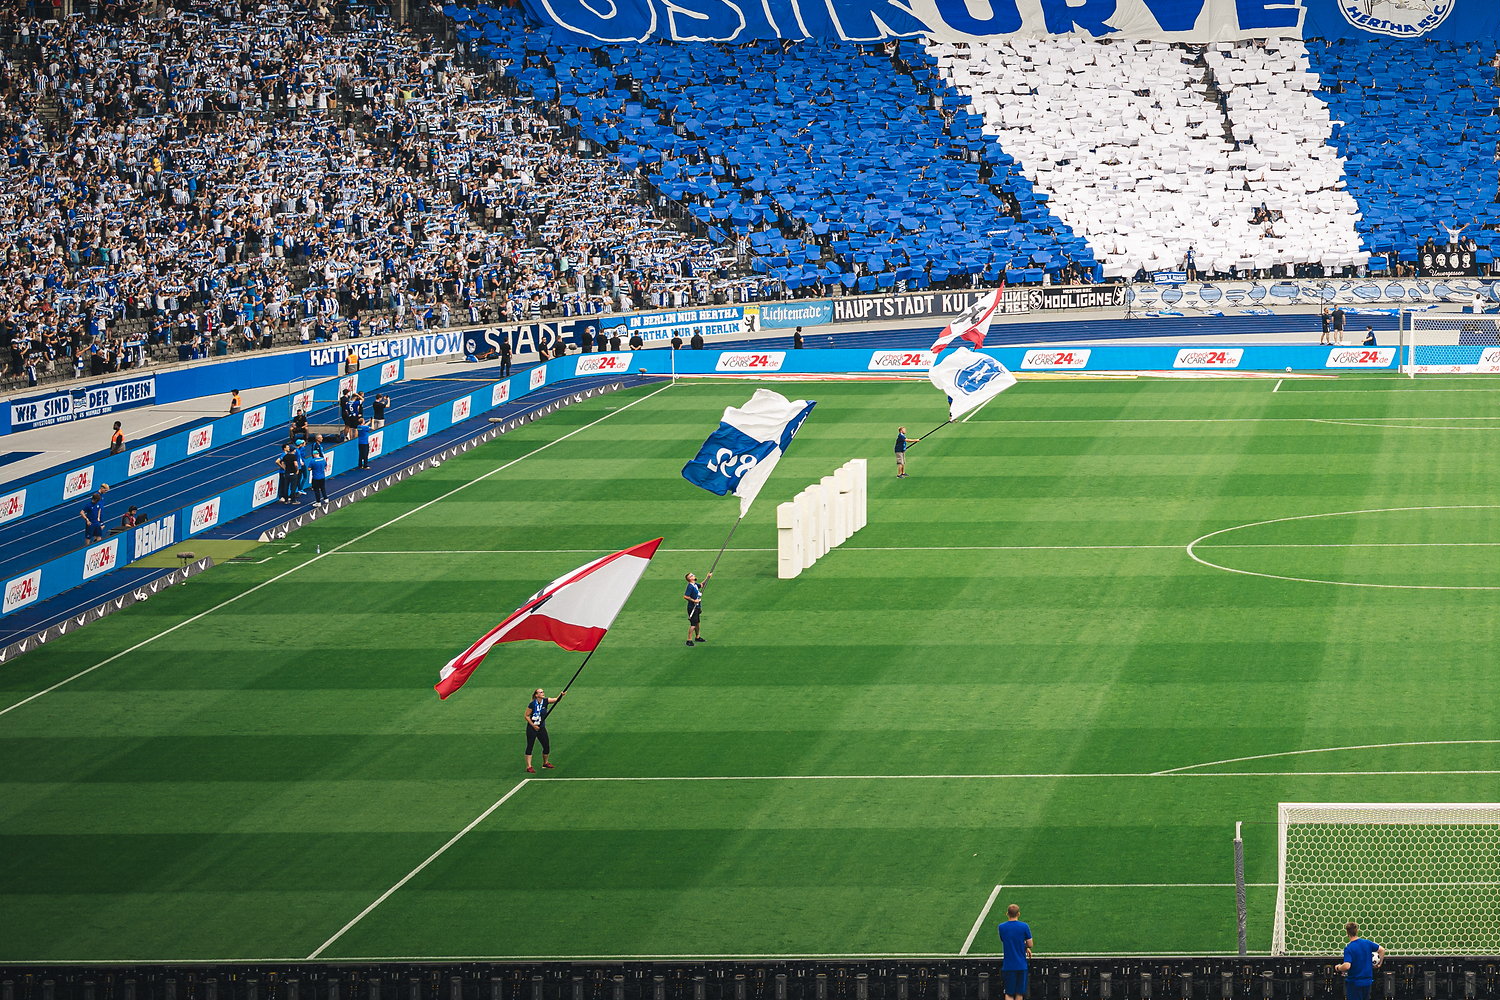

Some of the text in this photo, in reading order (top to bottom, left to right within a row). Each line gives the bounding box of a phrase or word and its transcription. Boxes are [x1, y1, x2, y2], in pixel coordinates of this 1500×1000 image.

[1347, 4, 1446, 32] HERTHA BSC
[834, 294, 934, 320] HAUPTSTADT
[1044, 292, 1112, 308] HOOLIGANS
[630, 308, 739, 327] IN BERLIN NUR HERTHA
[761, 305, 822, 322] Lichtenrade
[705, 323, 740, 335] BERLIN
[389, 332, 463, 360] GUMTOW
[16, 404, 37, 422] WIR
[44, 398, 70, 417] SIND
[89, 389, 110, 408] DER
[115, 381, 152, 402] VEREIN
